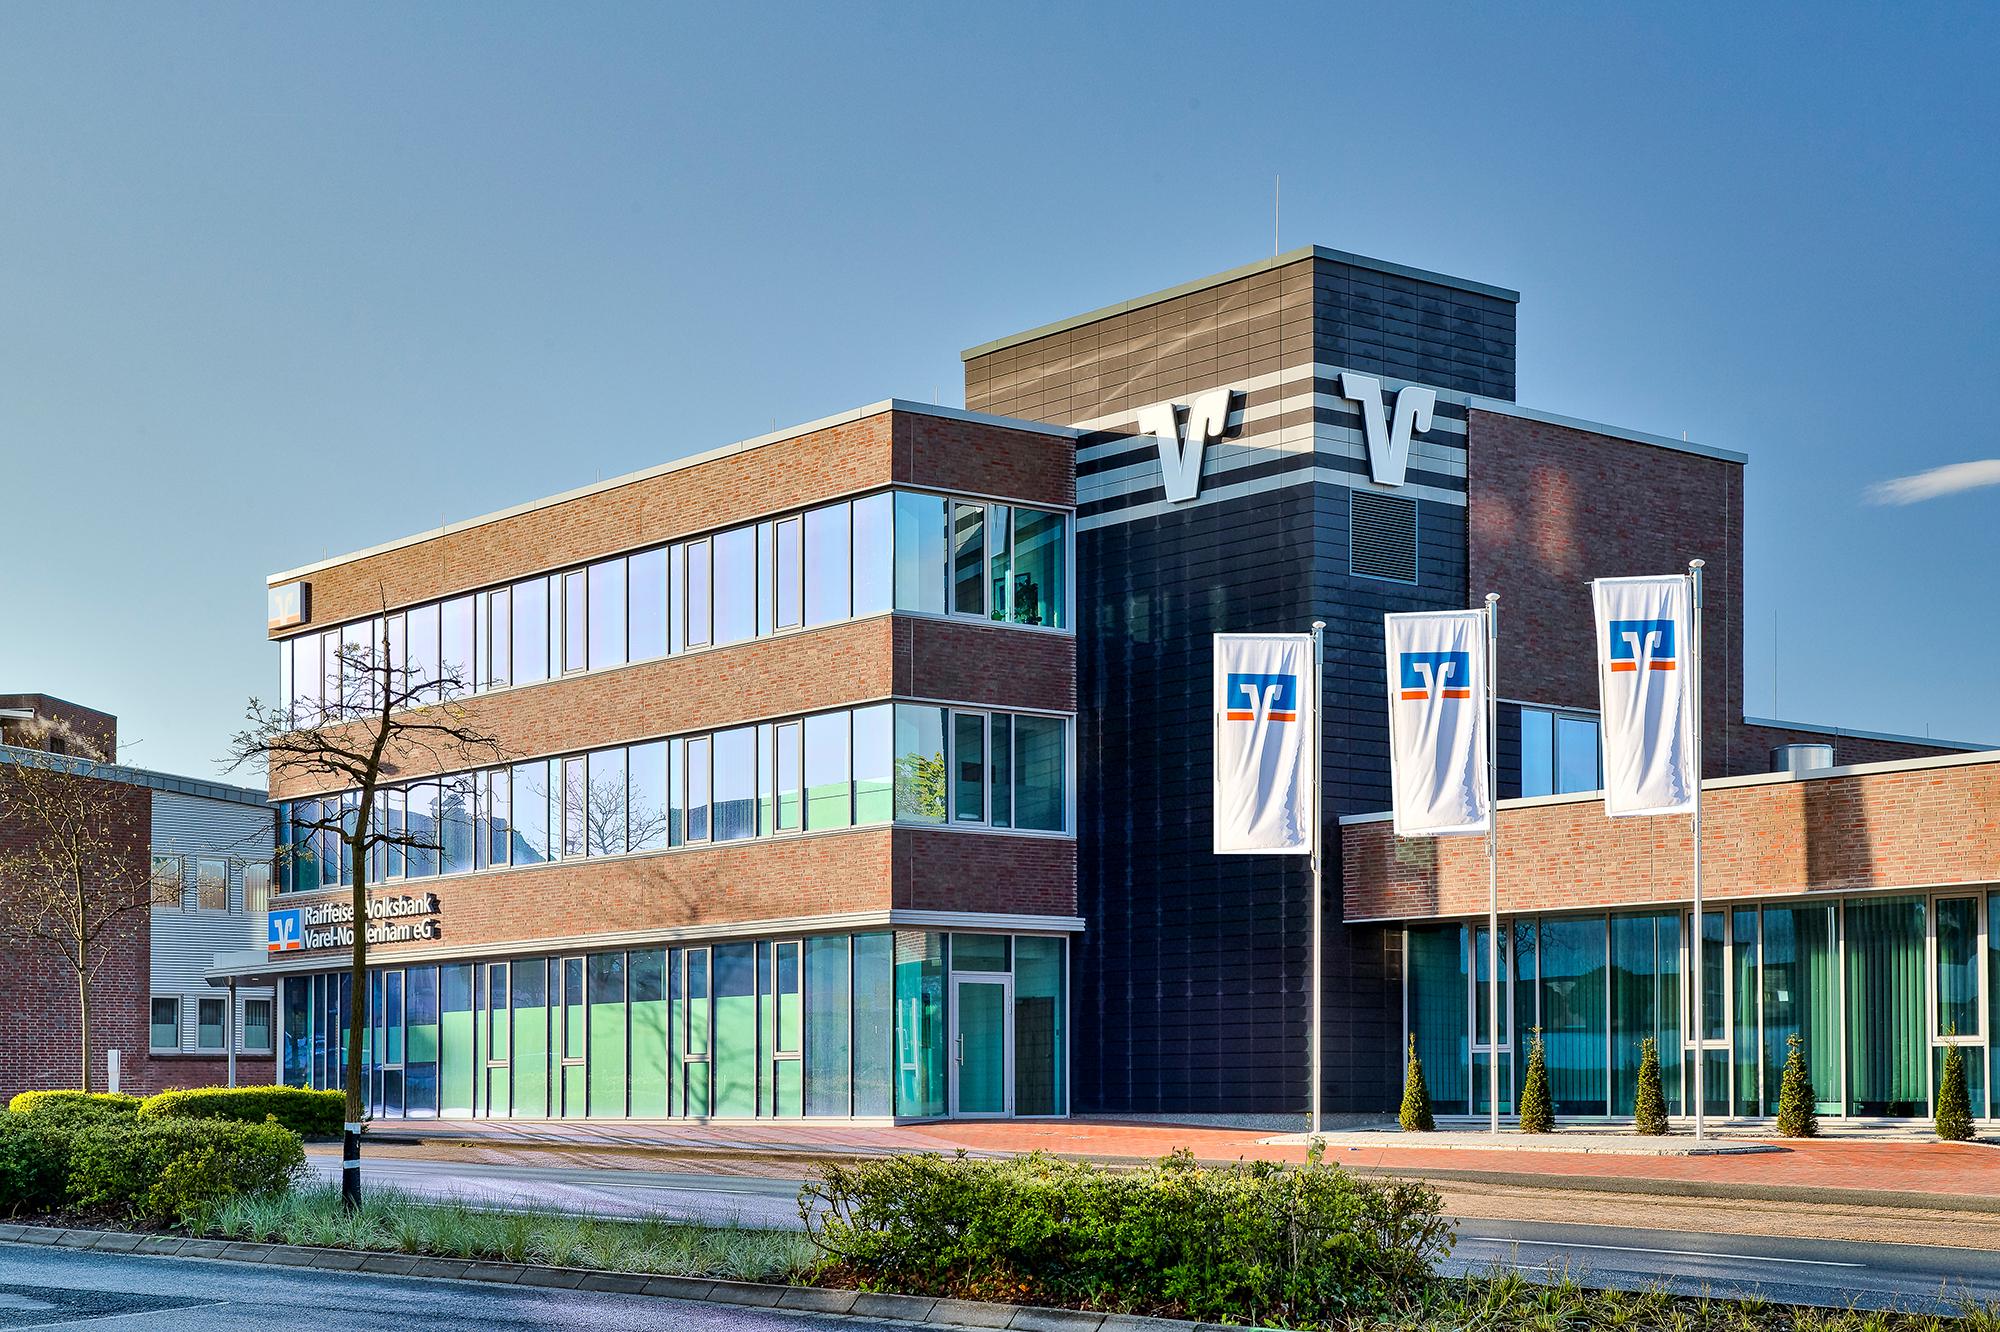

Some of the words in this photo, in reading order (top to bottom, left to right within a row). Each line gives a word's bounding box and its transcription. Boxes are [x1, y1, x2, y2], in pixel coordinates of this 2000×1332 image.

[305, 892, 432, 925] Raiffeise-Volksbank
[305, 918, 412, 949] Varel-Noenham
[413, 918, 431, 939] eG
